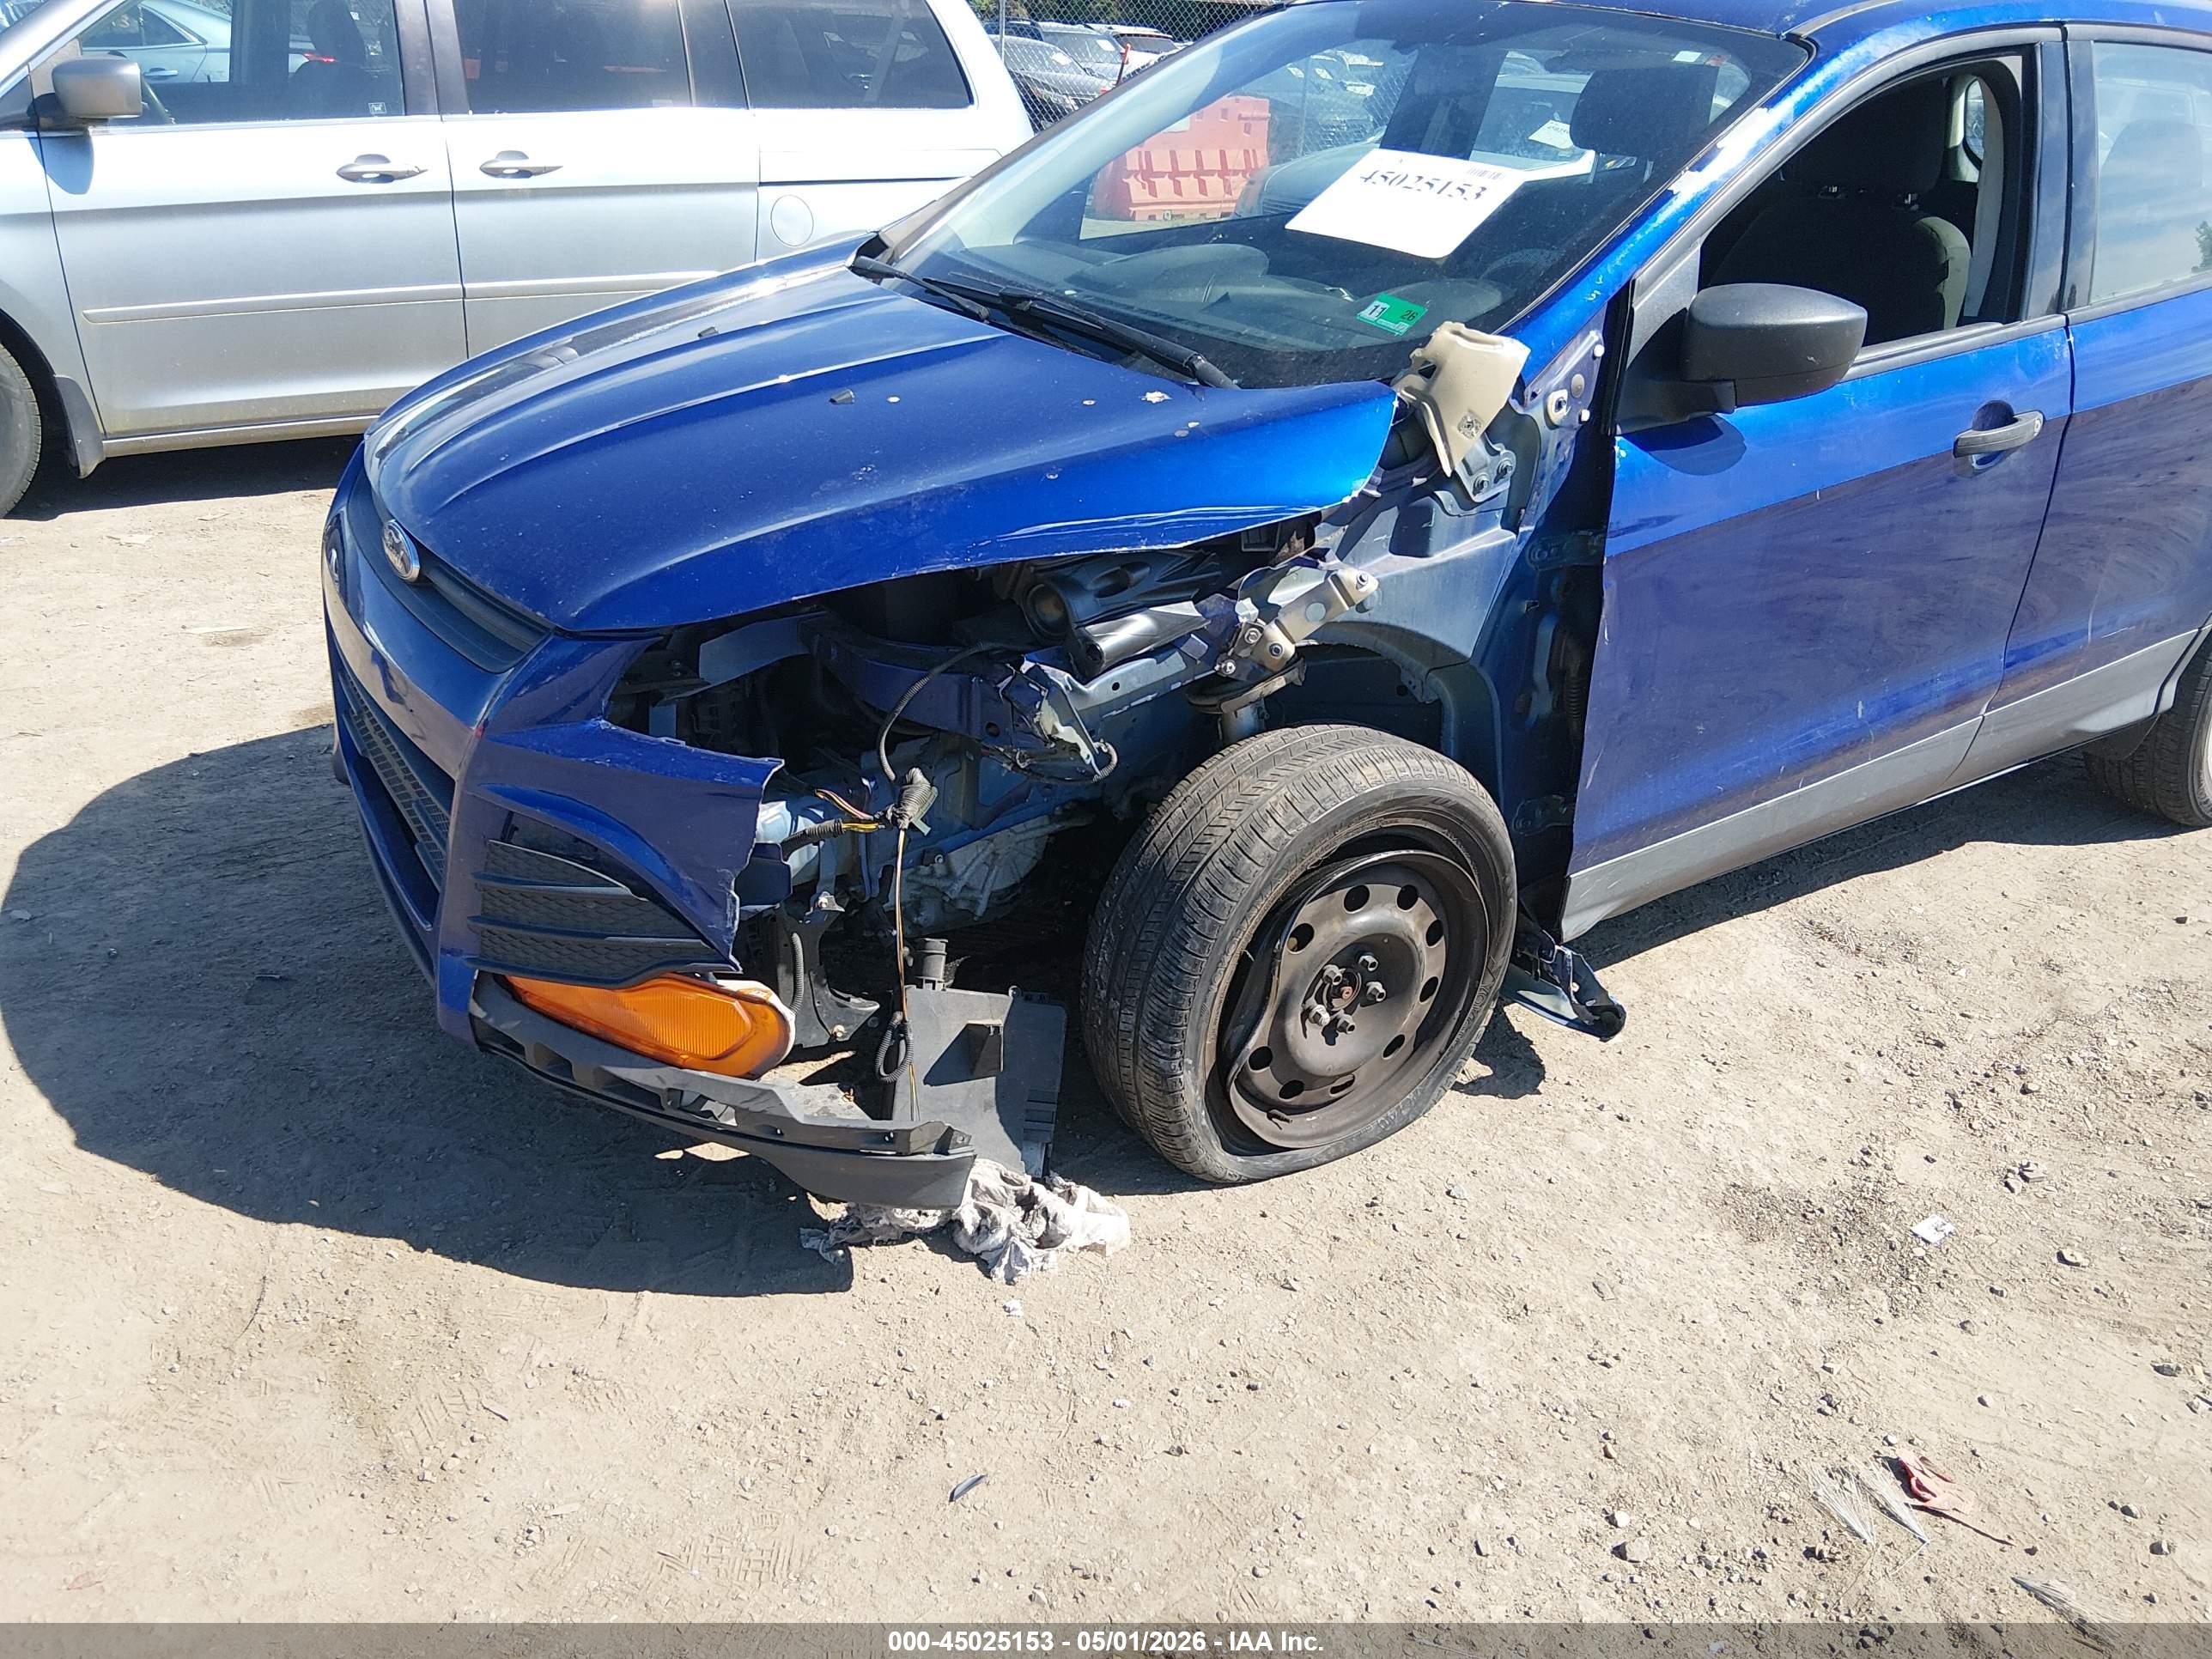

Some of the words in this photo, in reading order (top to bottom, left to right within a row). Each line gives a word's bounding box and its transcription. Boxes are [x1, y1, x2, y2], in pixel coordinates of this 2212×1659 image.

[1360, 170, 1487, 201] 45025153
[1369, 304, 1387, 318] 11
[1401, 309, 1419, 322] 26
